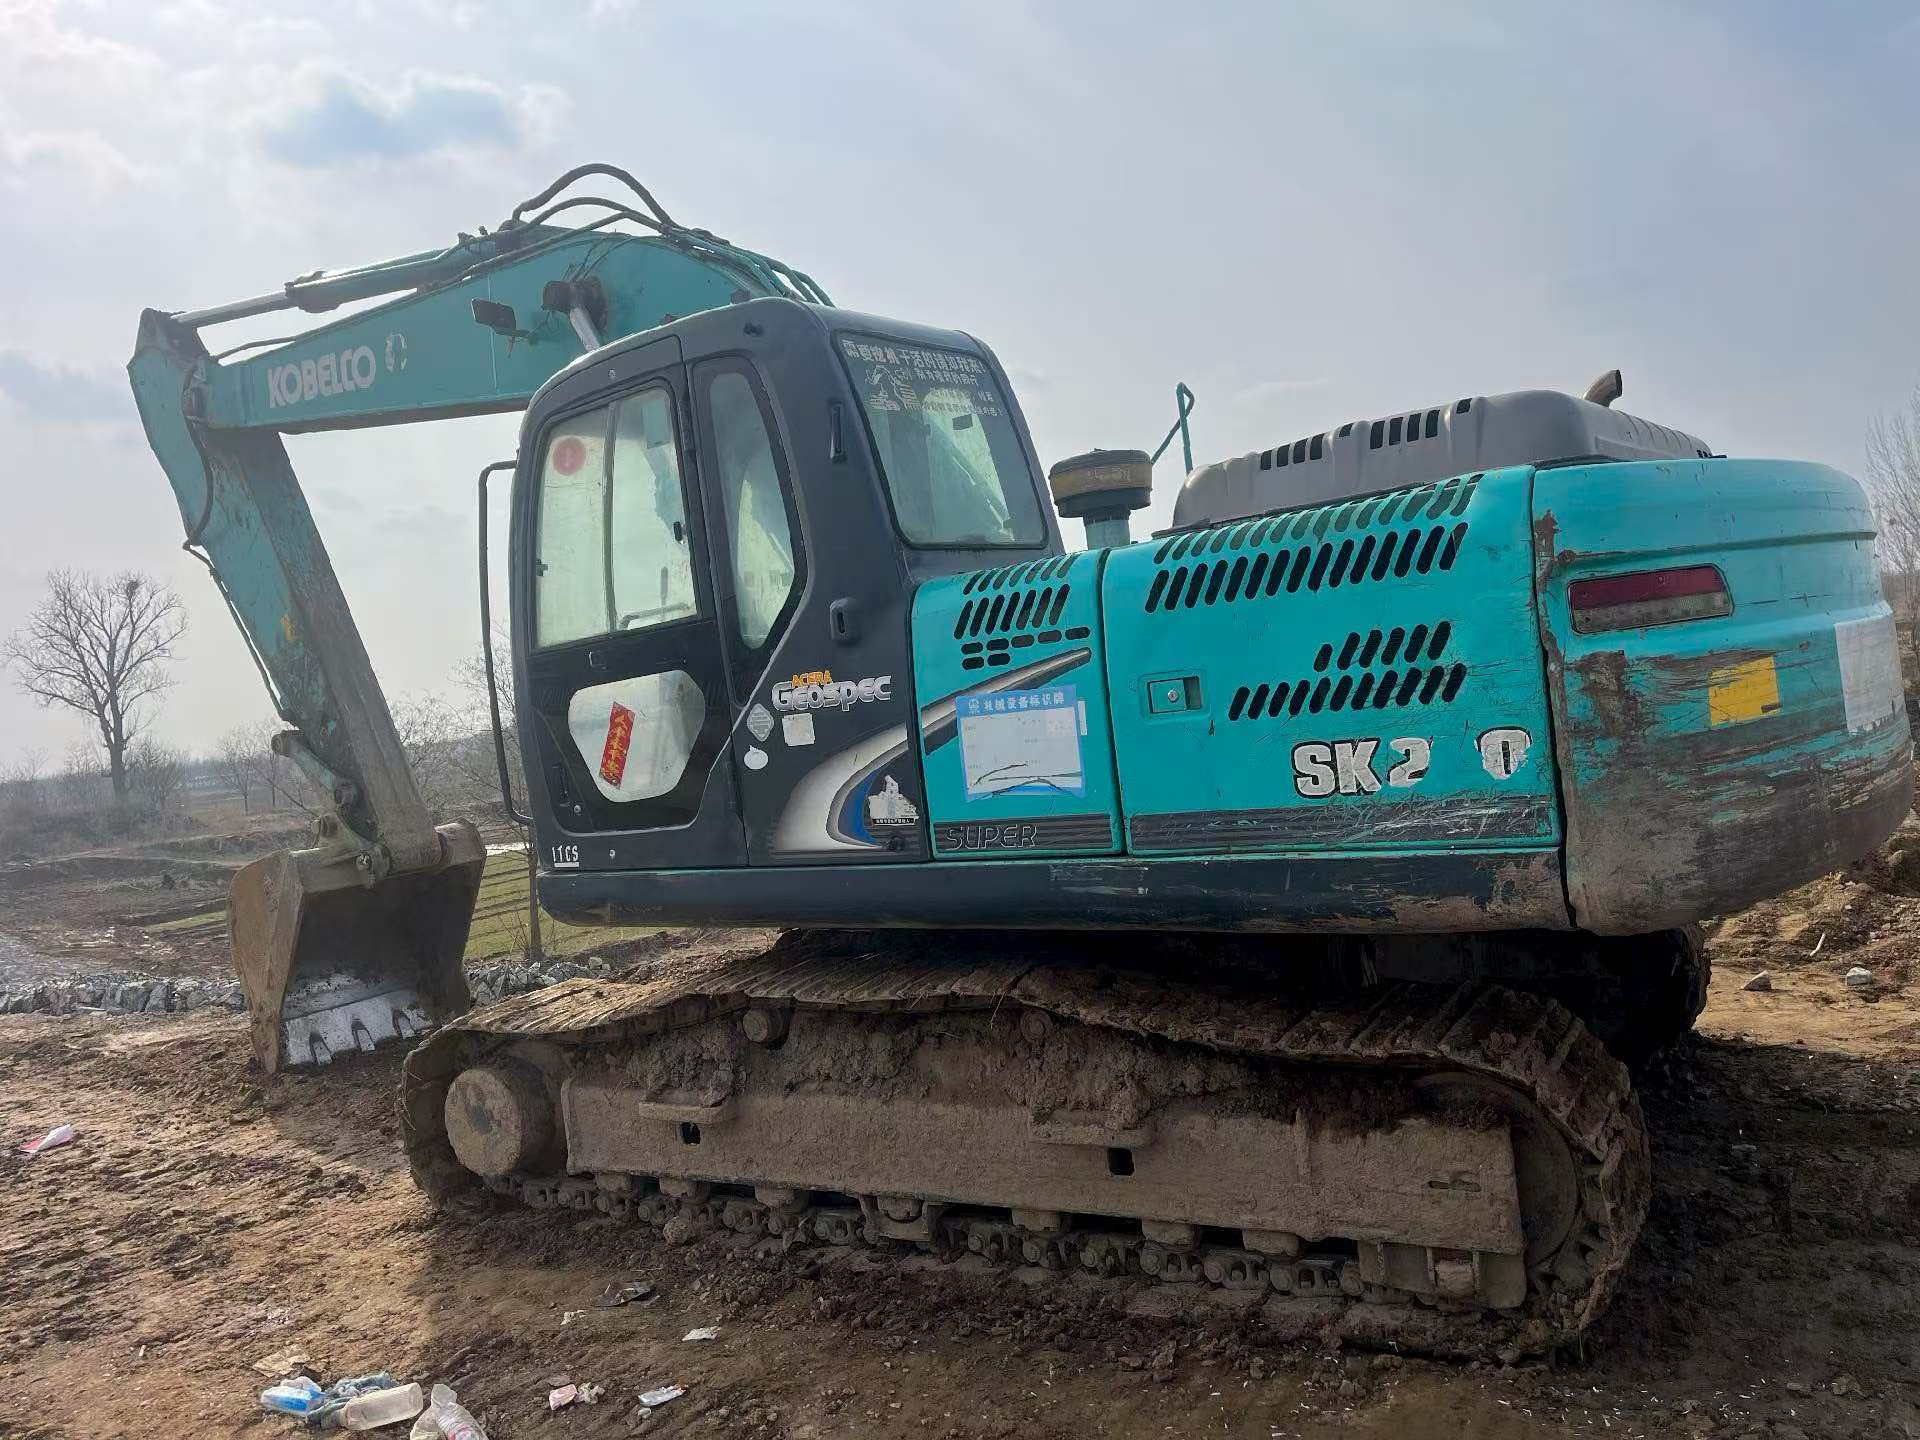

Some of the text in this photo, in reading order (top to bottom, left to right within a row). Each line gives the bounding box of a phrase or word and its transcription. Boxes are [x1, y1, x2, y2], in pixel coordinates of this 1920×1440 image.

[267, 345, 377, 408] KOBELCO
[791, 670, 832, 688] ACERA
[772, 675, 891, 711] Geospec
[946, 823, 1038, 850] SUPER
[552, 845, 579, 862] ITCS
